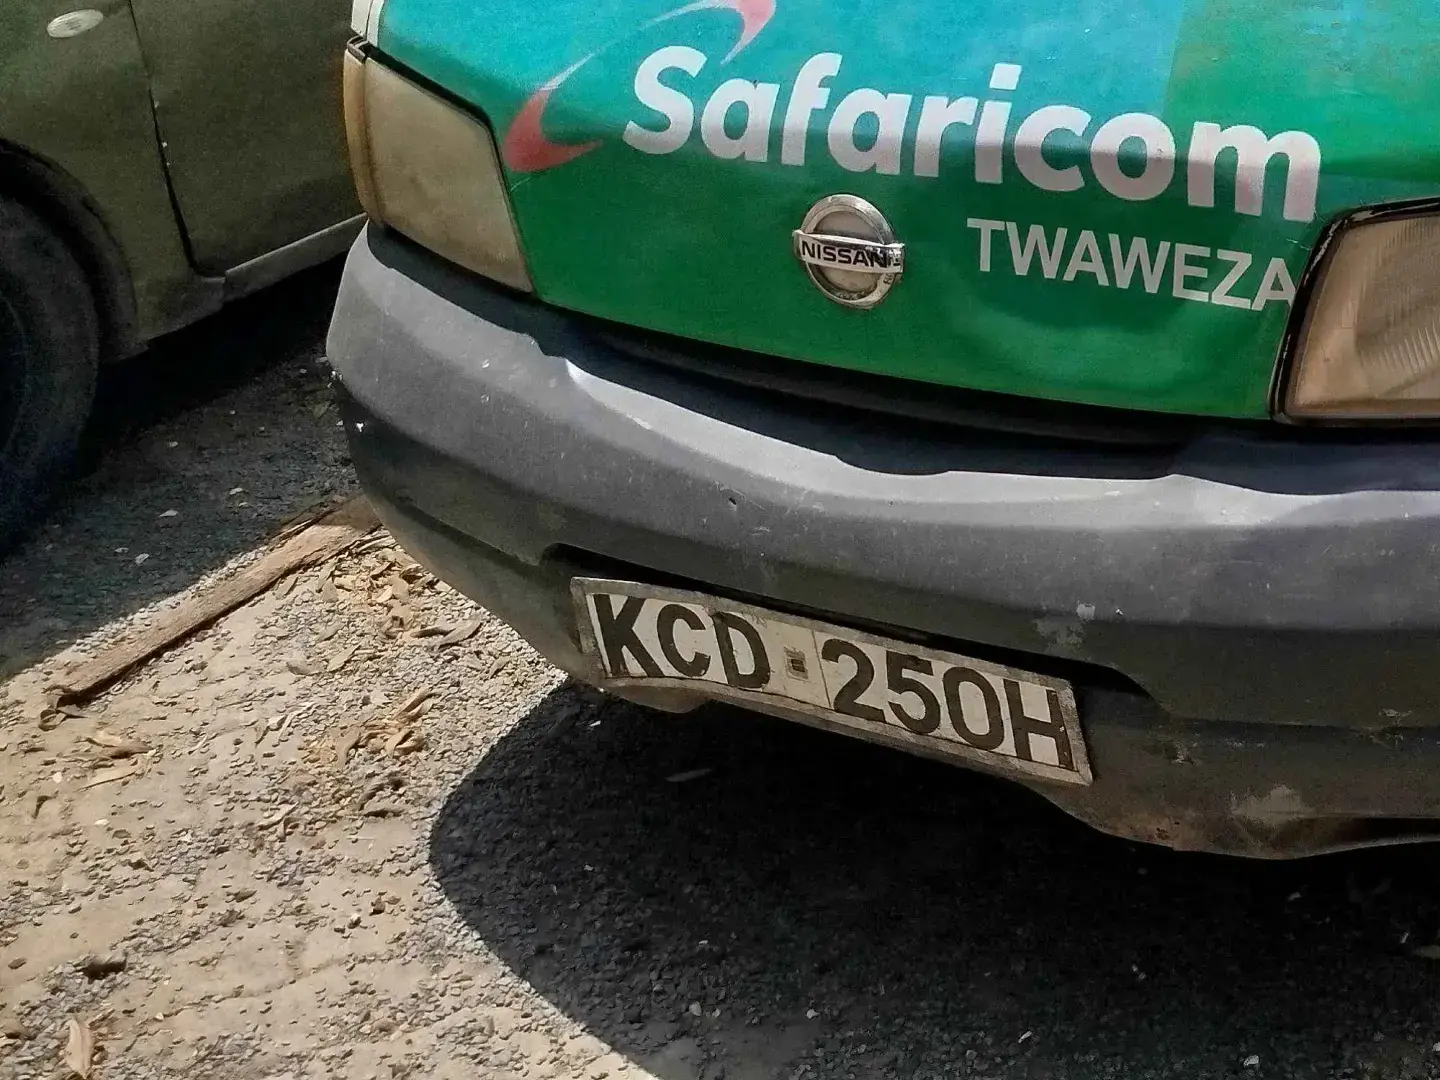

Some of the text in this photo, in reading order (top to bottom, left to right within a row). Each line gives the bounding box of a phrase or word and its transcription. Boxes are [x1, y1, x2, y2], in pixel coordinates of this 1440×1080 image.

[622, 45, 1321, 223] Safaricom
[801, 240, 888, 269] NISSAN
[967, 217, 1297, 311] TWAWEZA
[593, 593, 1074, 770] KCD 250H
